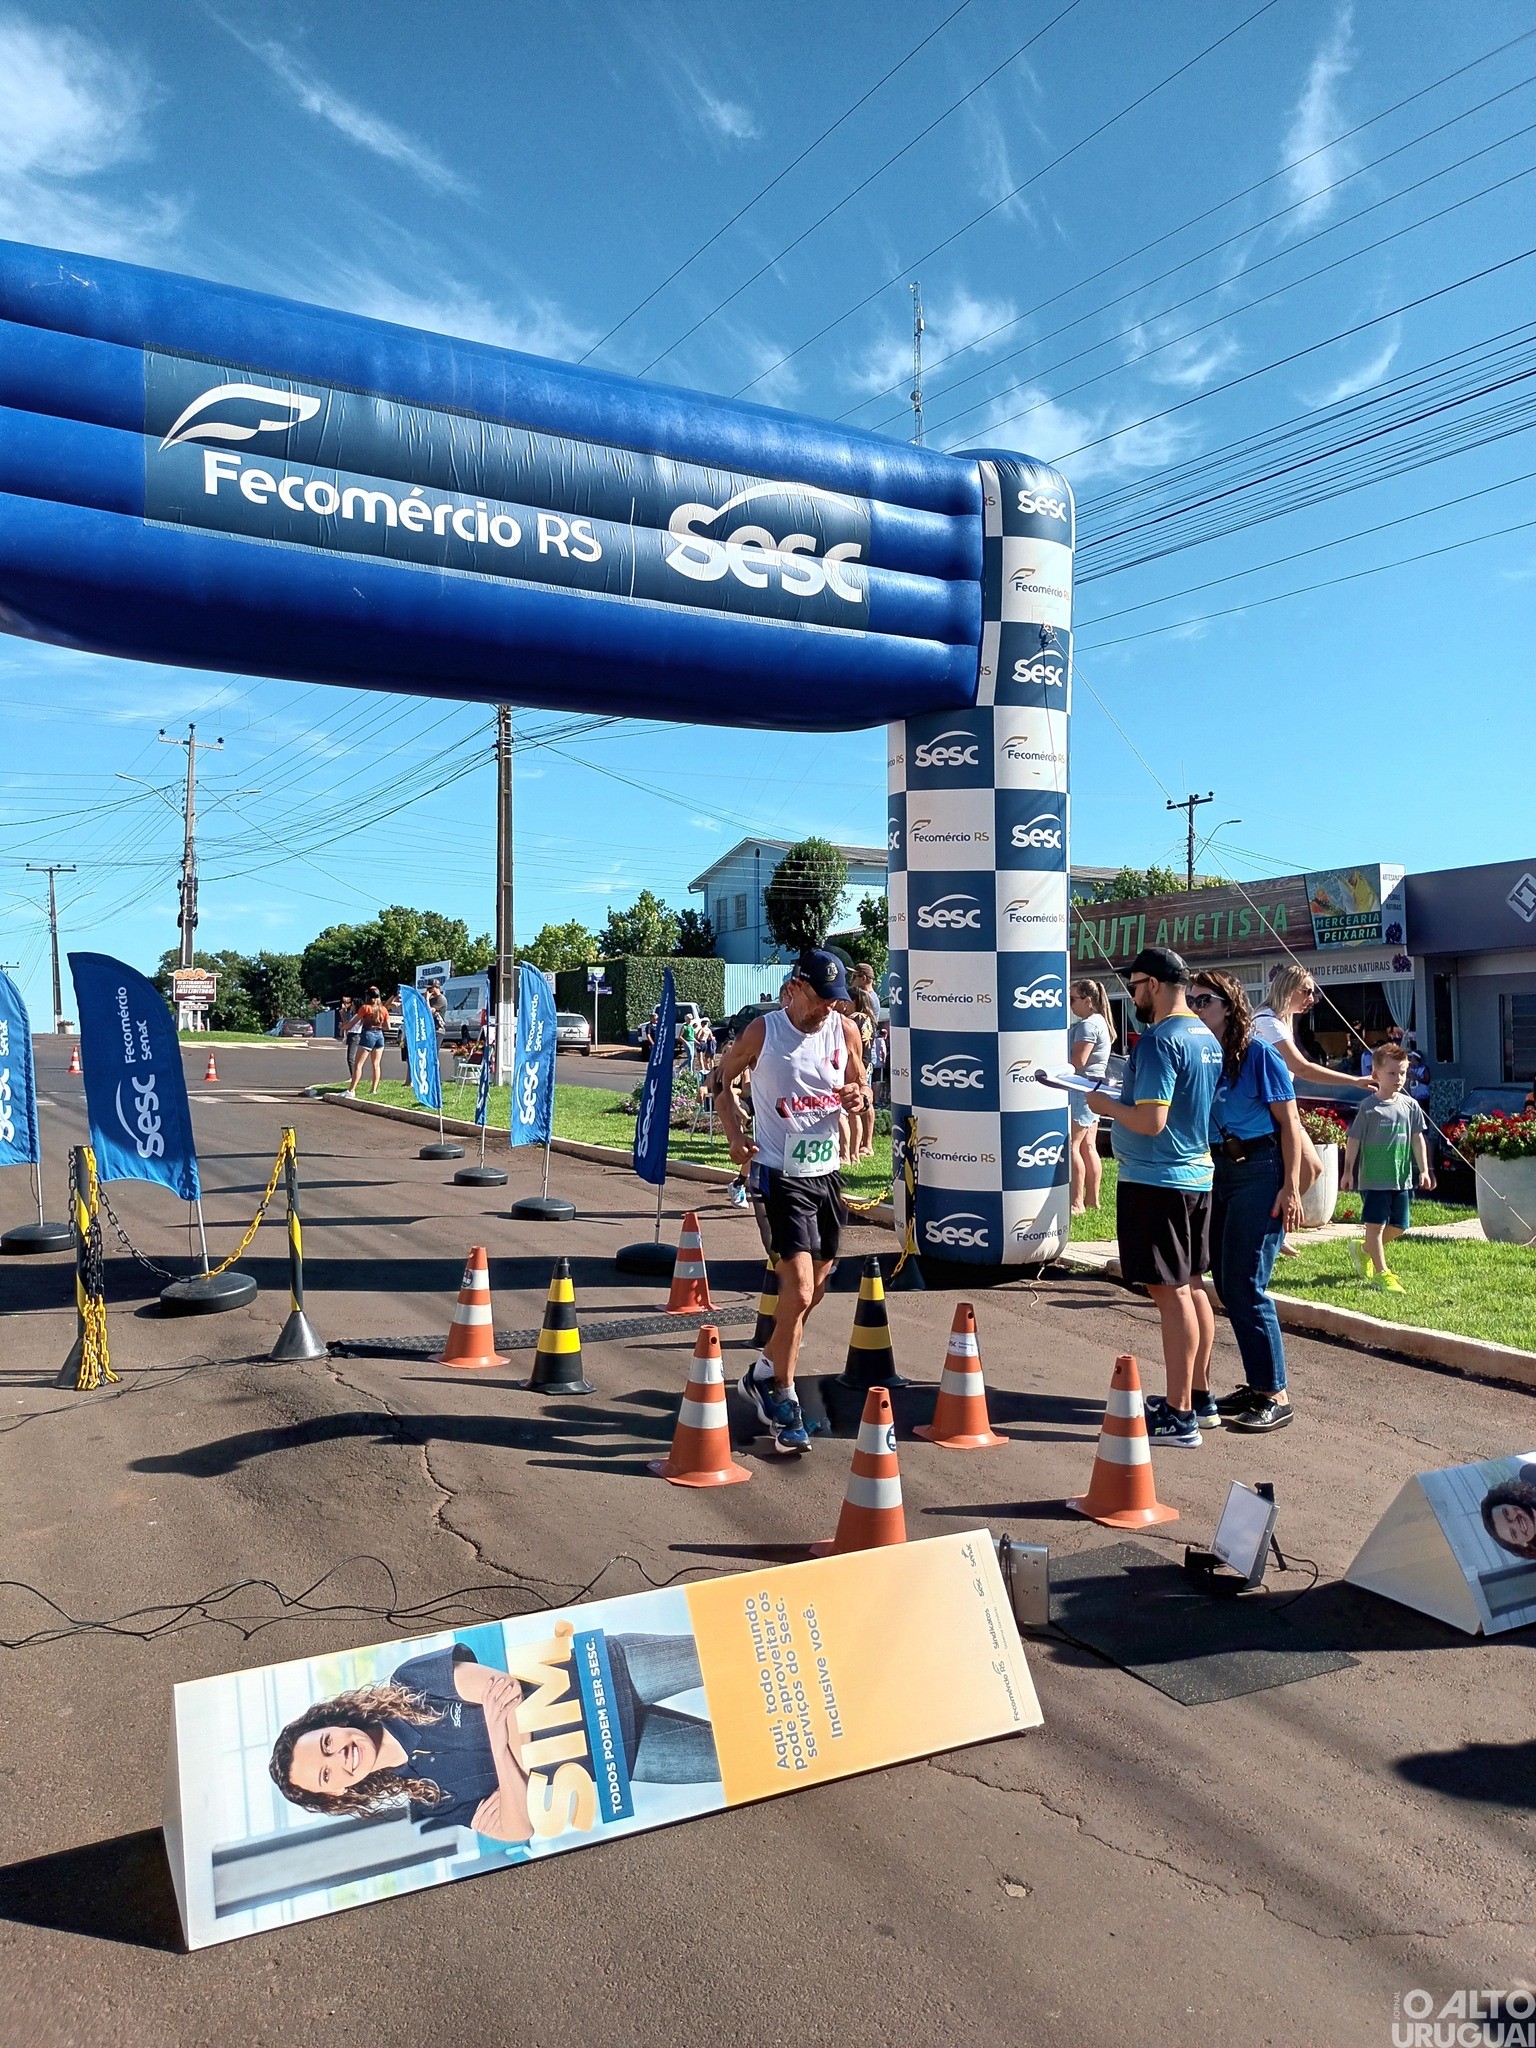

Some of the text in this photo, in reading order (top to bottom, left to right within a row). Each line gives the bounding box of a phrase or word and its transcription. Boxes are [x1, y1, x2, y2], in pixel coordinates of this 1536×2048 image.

[203, 448, 602, 563] Fecomércio RS
[1015, 581, 1063, 598] Fecomércio
[1008, 749, 1058, 762] Fecomércio
[914, 831, 990, 843] Fecomércio RS
[1009, 911, 1058, 923] Fecomércio
[1155, 903, 1288, 944] AMETISTA
[1316, 913, 1379, 929] MERCEARIA
[1324, 927, 1377, 942] PEIXARIA
[1327, 965, 1331, 975] E
[1332, 963, 1357, 975] PEDRAS
[1358, 960, 1390, 973] NATURAIS
[917, 991, 992, 1004] Fecomércio RS
[115, 986, 137, 1064] Fecomércio
[792, 1139, 834, 1164] 438
[920, 1148, 996, 1163] Fecomércio RS
[1154, 1425, 1177, 1436] FILA
[984, 1608, 1000, 1650] Sindicatos
[802, 1603, 844, 1738] Inclusive você.
[998, 1660, 1006, 1673] RS
[745, 1598, 790, 1769] Aqui, todo mundo
[759, 1591, 808, 1771] pode aproveitar os
[775, 1597, 818, 1758] serviços do Sesc.
[1003, 1673, 1020, 1721] Fecomércio
[585, 1637, 623, 1814] TODOS PODEM SER SESC.
